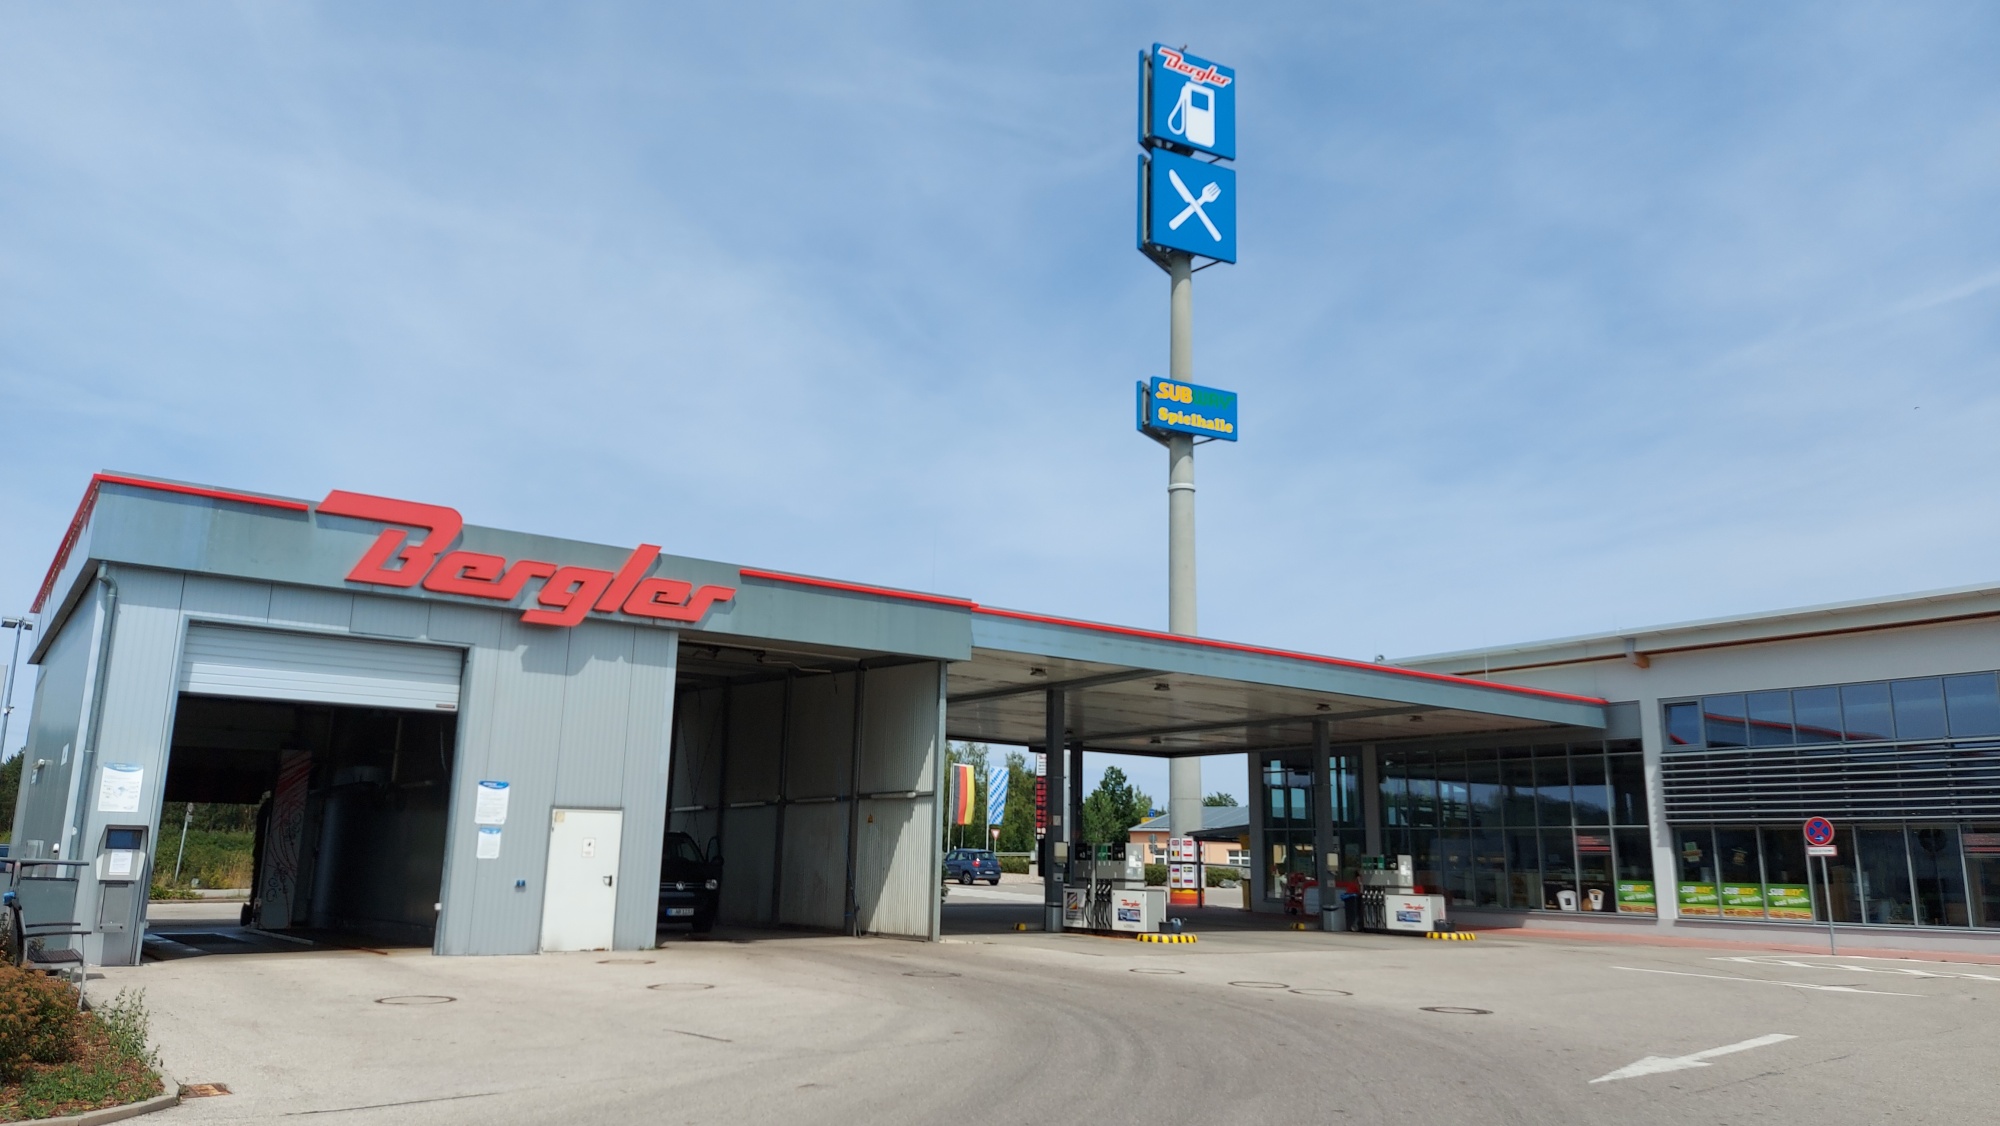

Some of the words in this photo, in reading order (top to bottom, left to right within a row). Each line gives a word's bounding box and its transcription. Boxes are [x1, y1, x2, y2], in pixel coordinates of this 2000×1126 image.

[1158, 47, 1231, 87] Bergler
[1155, 381, 1235, 410] SUBWAY
[1157, 406, 1234, 434] Spielhalle
[315, 489, 737, 628] Bergler
[1618, 884, 1650, 892] SUBWAY
[1679, 885, 1714, 894] SUBWAY
[1722, 886, 1758, 895] SUBWAY
[1768, 888, 1804, 896] SUBWAY
